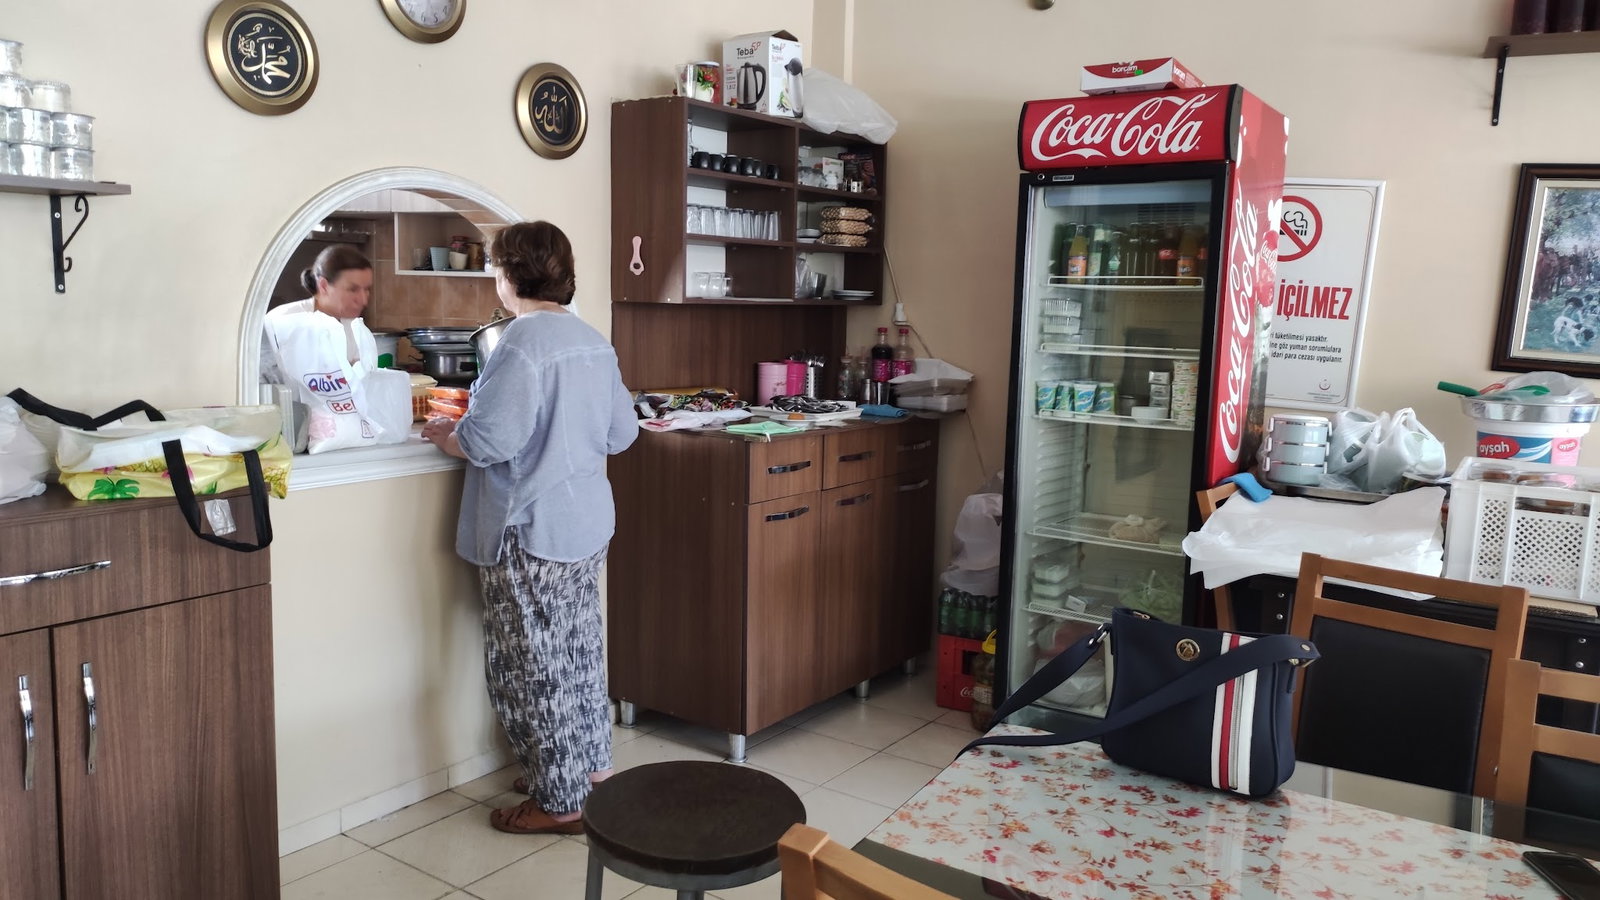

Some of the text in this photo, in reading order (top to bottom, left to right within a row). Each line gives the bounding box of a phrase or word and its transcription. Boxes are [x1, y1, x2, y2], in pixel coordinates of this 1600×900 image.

[736, 46, 754, 56] Teba
[1031, 92, 1219, 161] Coca-Cola
[1276, 278, 1353, 321] İÇİLMEZ
[1220, 178, 1258, 464] Coca-Cola
[1275, 331, 1304, 341] tüketilmesi
[1279, 342, 1289, 350] göz
[1289, 343, 1308, 352] yuman
[1308, 344, 1342, 353] sorumlulara
[1284, 352, 1298, 361] para
[1480, 441, 1510, 456] ayşah
